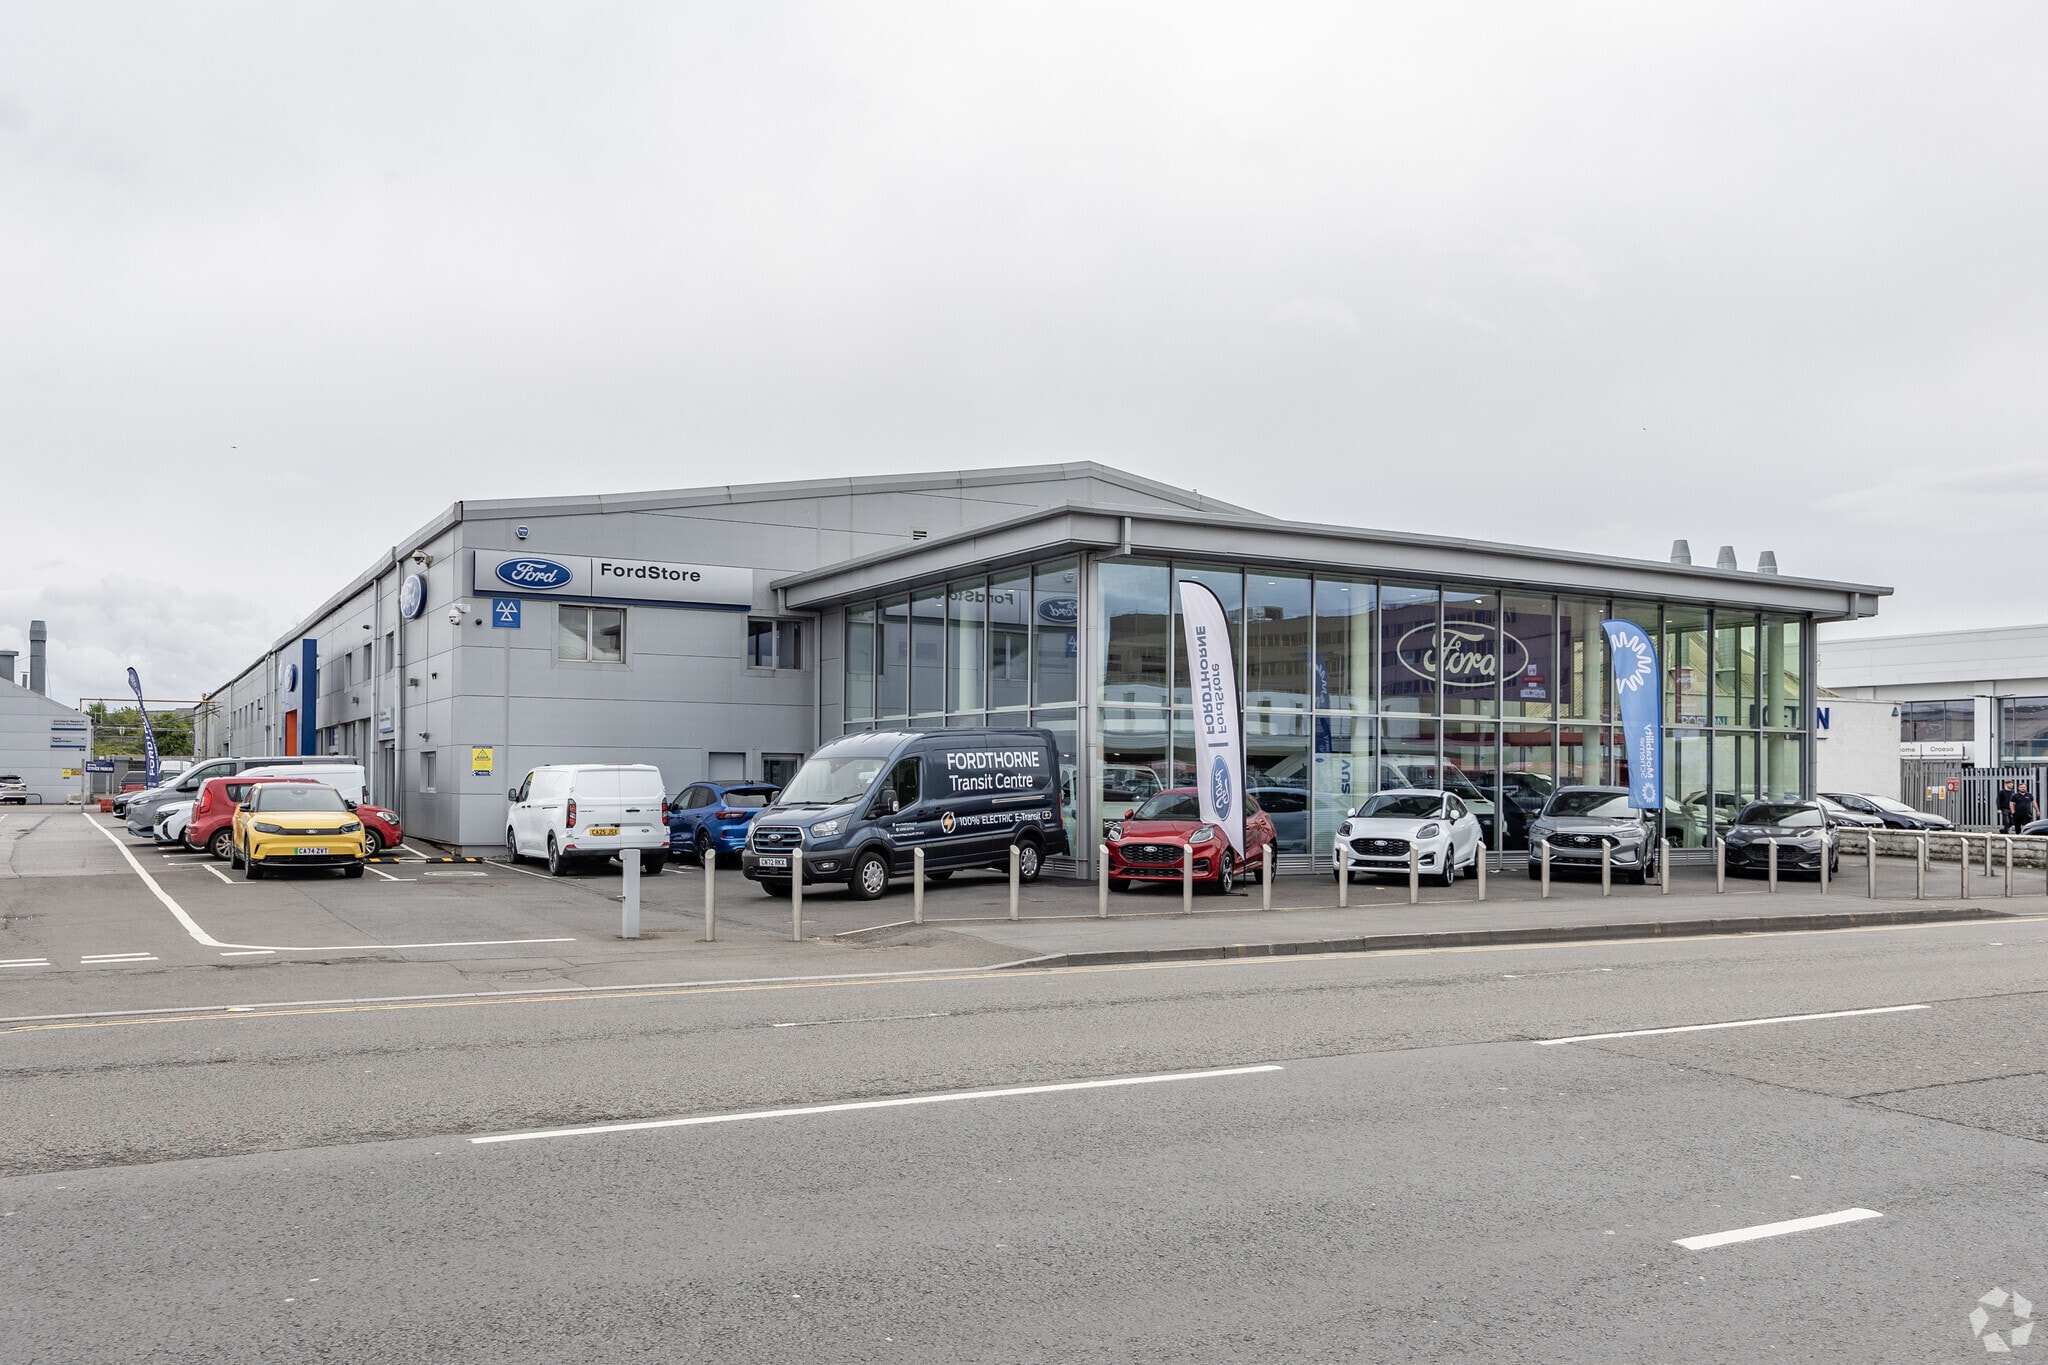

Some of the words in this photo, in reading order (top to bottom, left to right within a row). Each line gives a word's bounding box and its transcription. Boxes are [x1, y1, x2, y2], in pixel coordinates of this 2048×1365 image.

[511, 561, 558, 583] Ford
[601, 563, 701, 582] FordStore
[946, 751, 1040, 770] FORDTHORNE
[949, 774, 993, 791] Transit
[995, 773, 1033, 789] Centre
[1341, 760, 1351, 794] SUV
[959, 816, 980, 826] 100%
[982, 813, 1013, 825] ELECTRIC
[1015, 811, 1041, 822] E-Transit
